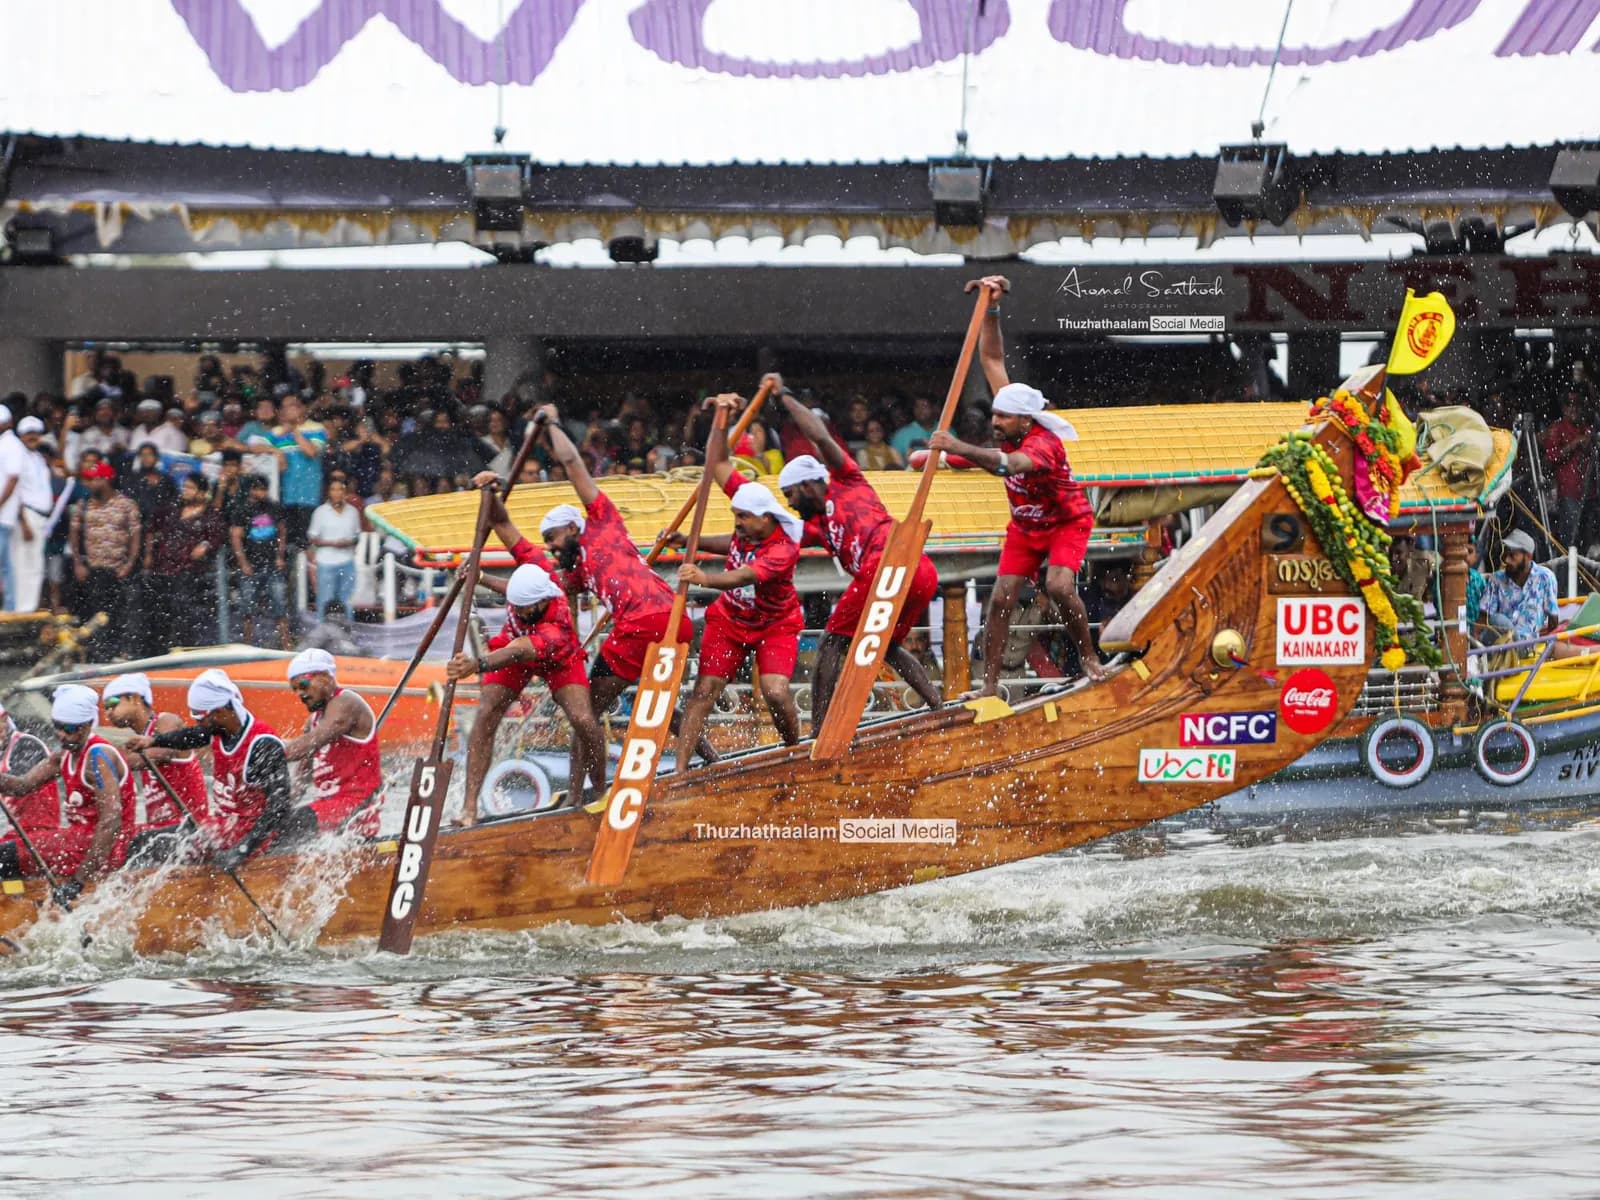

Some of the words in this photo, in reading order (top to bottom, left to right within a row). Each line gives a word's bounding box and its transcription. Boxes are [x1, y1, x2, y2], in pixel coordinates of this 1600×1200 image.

[855, 566, 907, 666] UBC
[1284, 603, 1359, 635] UBC
[653, 647, 676, 682] 3
[1283, 641, 1358, 657] KAINAKARY
[1184, 714, 1270, 742] NCFC
[608, 690, 672, 830] UBC
[418, 766, 437, 798] 5
[391, 805, 432, 919] UBC
